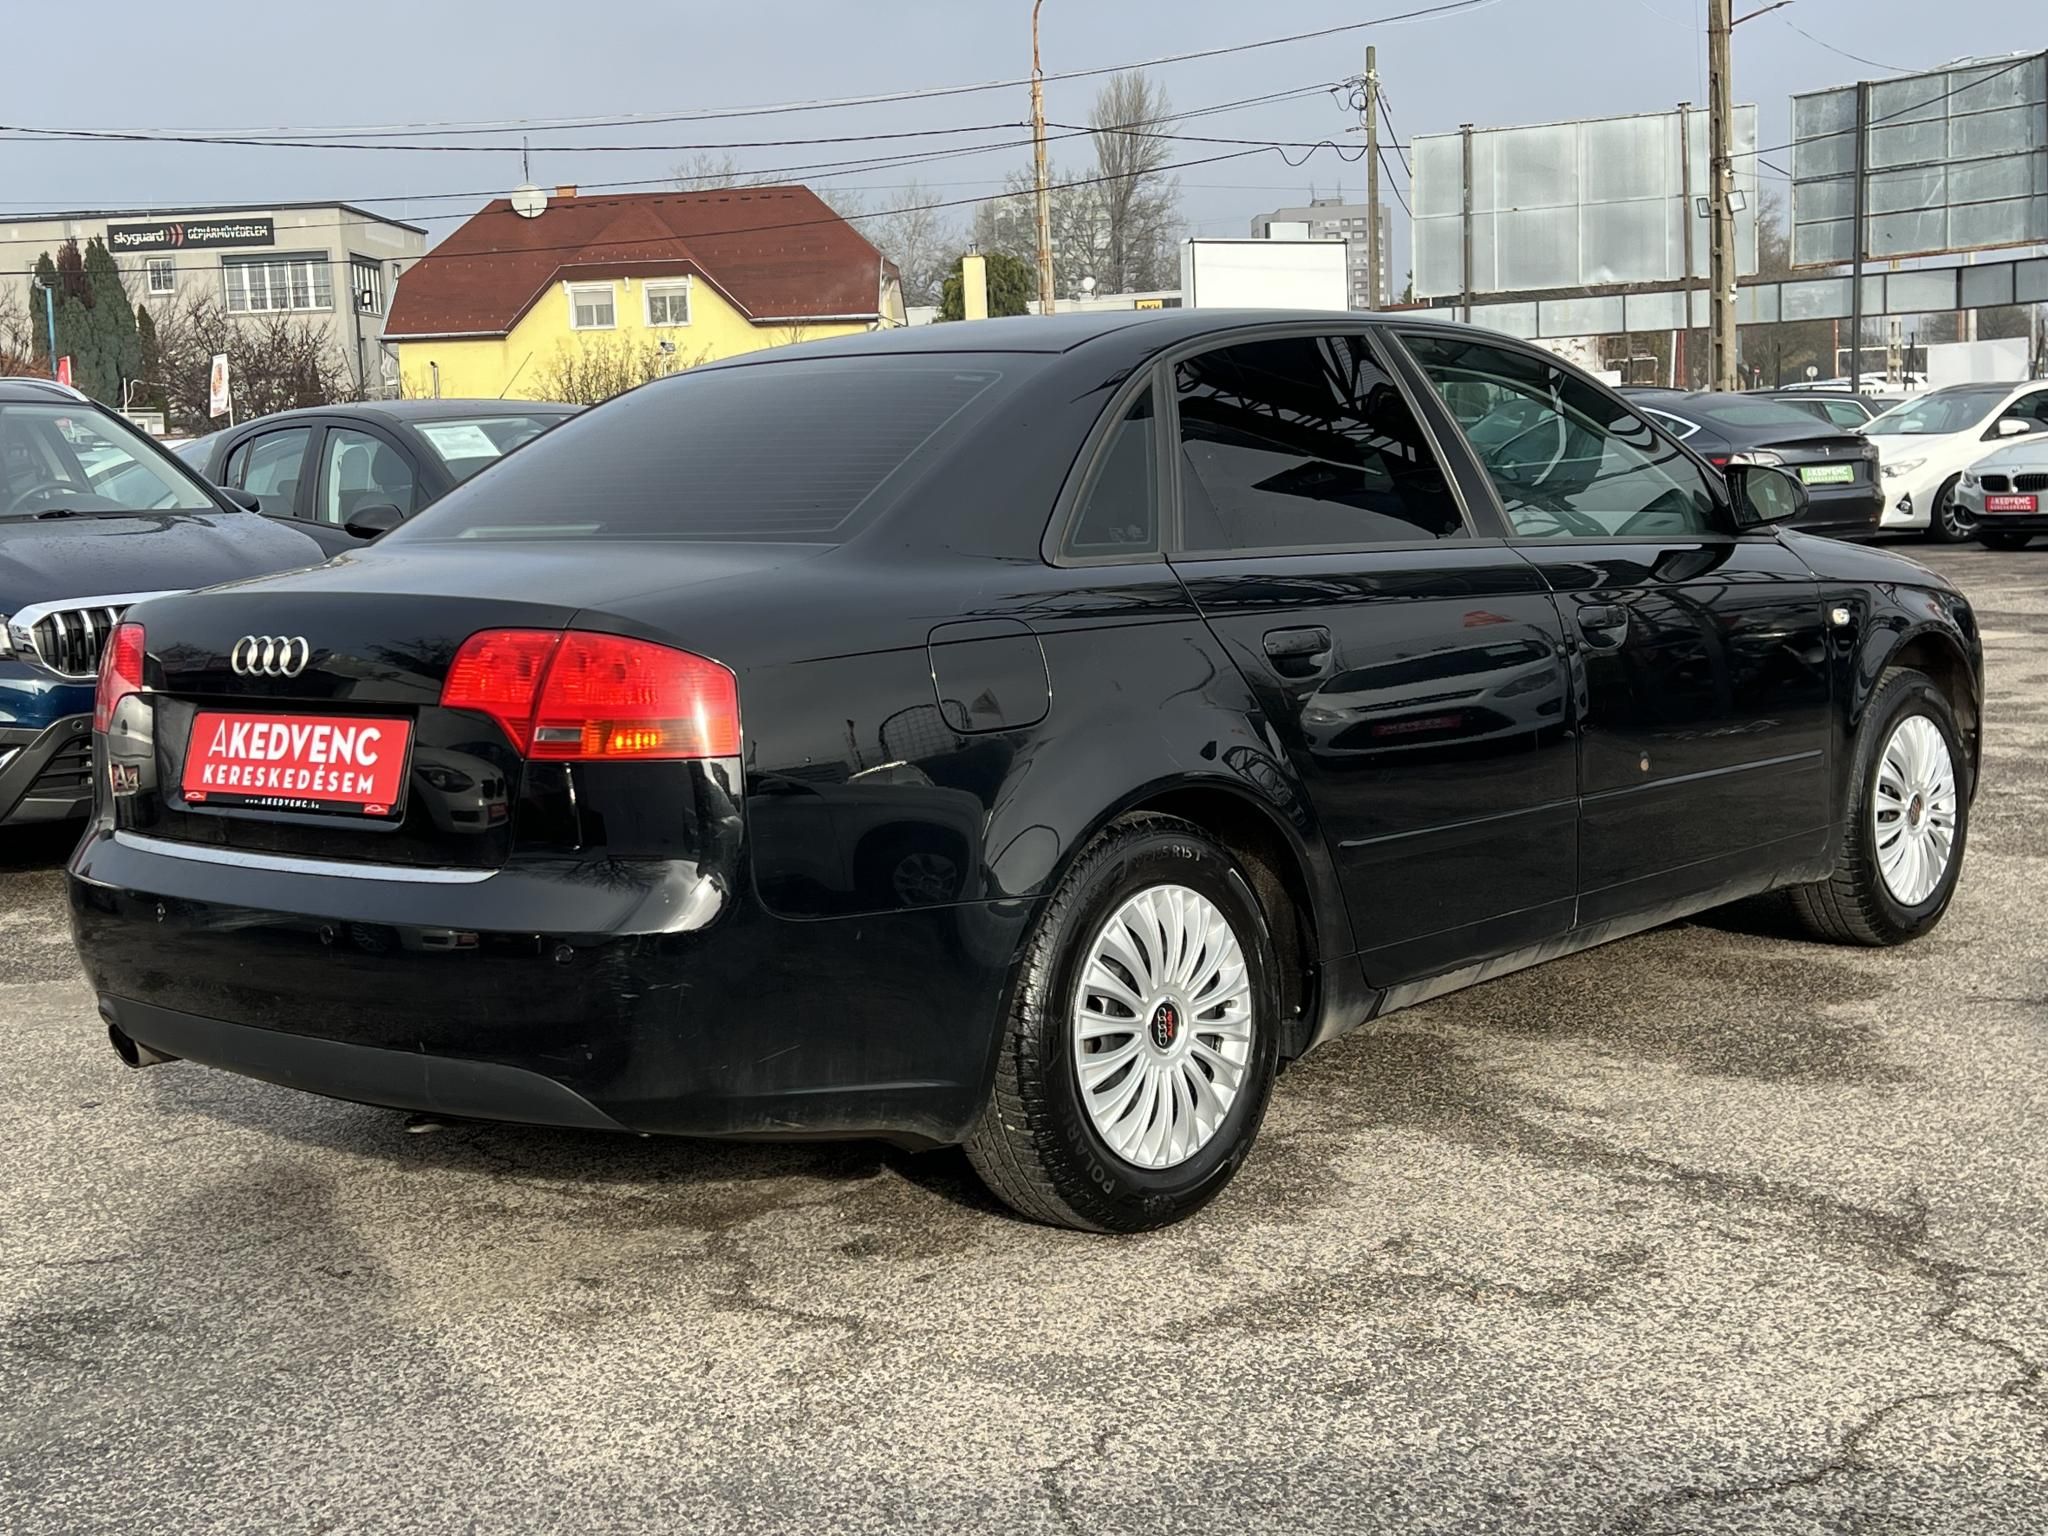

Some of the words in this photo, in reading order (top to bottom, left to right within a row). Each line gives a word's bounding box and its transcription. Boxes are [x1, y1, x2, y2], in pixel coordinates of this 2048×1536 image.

[113, 229, 165, 246] skyguard
[208, 719, 382, 766] AKEDVENC
[202, 764, 375, 795] KERESKEDÉSEM
